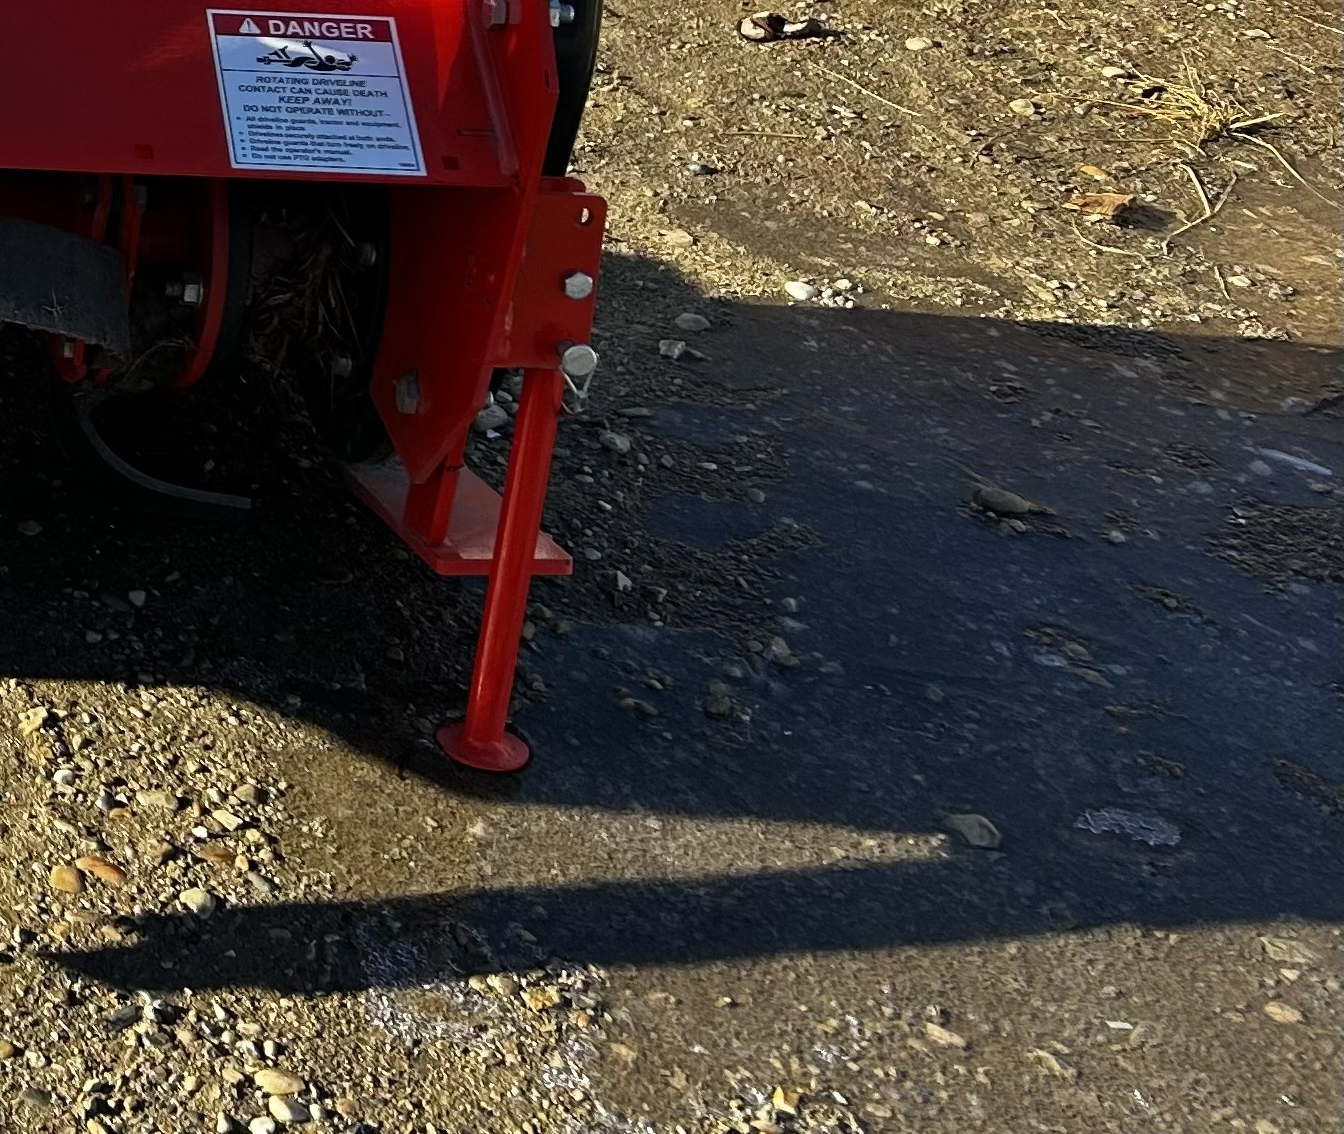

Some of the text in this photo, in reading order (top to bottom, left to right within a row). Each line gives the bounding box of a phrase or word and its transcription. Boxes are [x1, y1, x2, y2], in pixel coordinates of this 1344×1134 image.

[267, 20, 375, 39] DANGER
[255, 75, 309, 86] ROTATING
[238, 84, 388, 98] CONTACT CAN CAUSE DEATH
[278, 96, 310, 104] KEEP
[243, 104, 259, 112] DO
[261, 105, 283, 113] NOT
[285, 106, 334, 115] OPERATE
